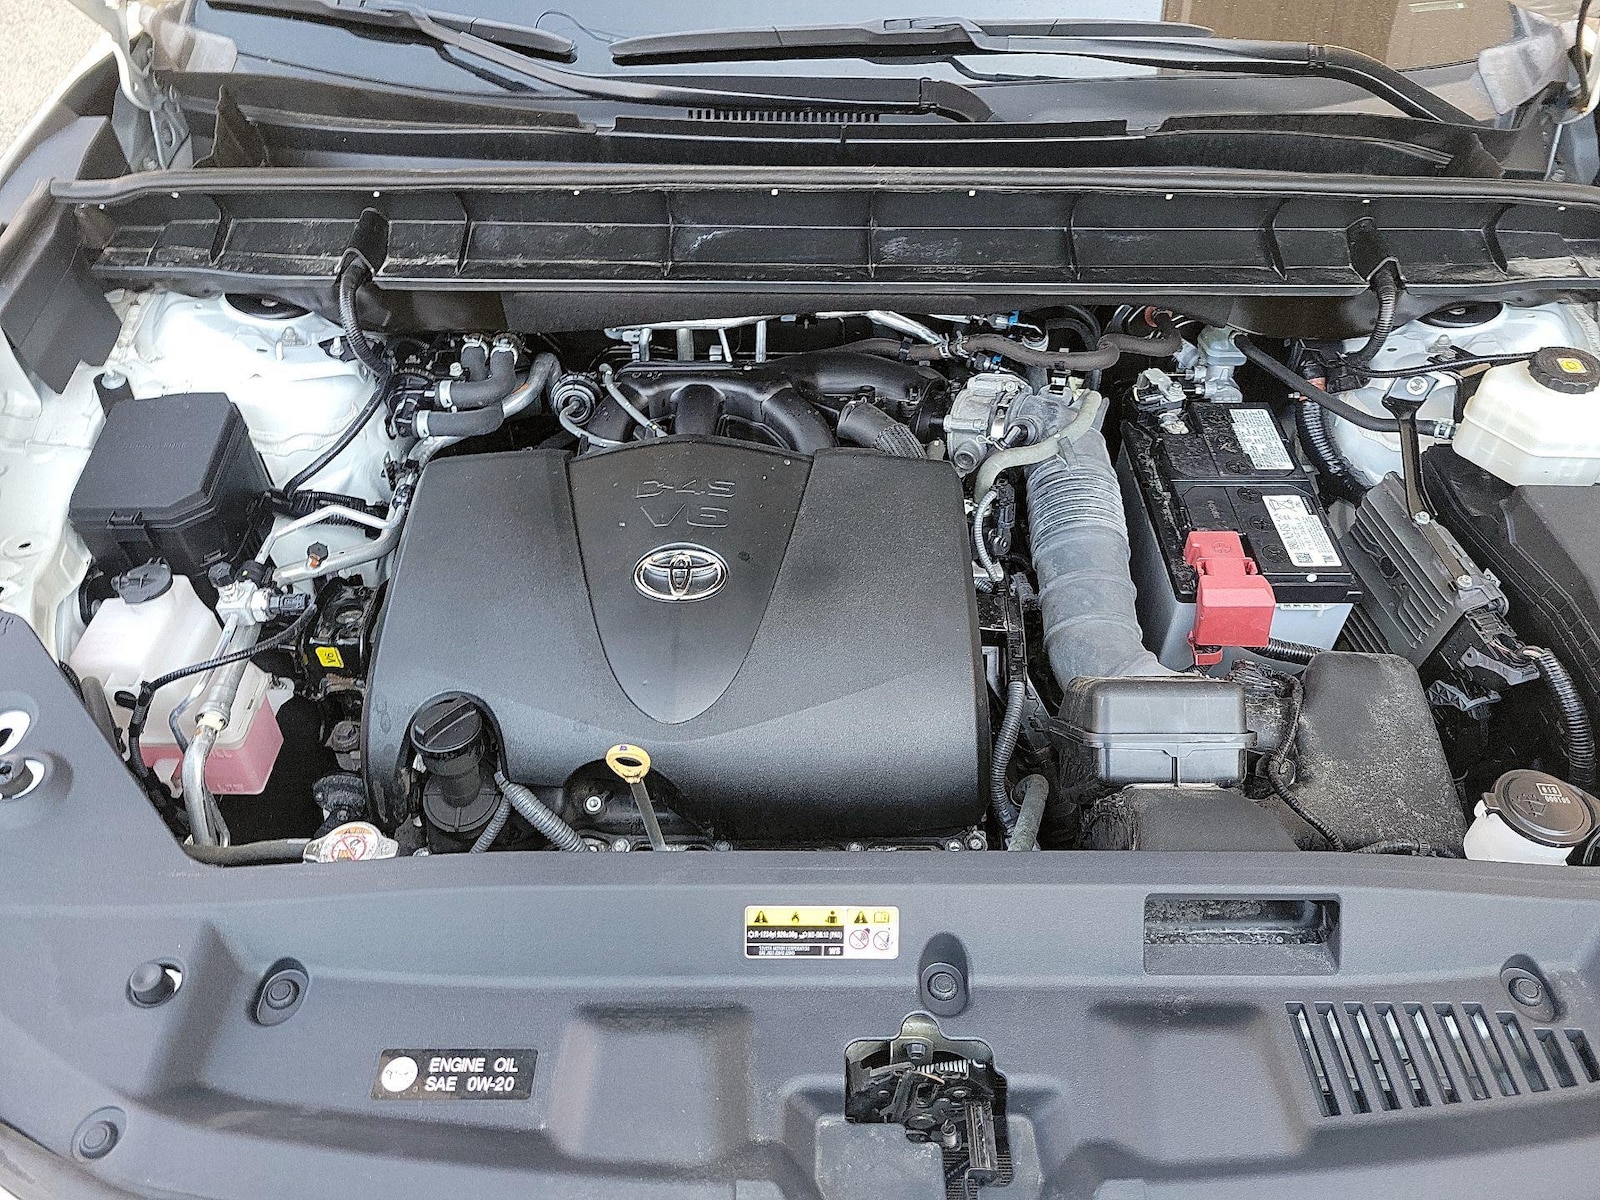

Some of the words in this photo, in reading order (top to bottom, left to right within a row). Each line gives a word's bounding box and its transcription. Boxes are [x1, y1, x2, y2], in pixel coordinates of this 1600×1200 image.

[640, 503, 729, 528] V6
[429, 1056, 486, 1073] ENGINE
[493, 1056, 518, 1073] OIL
[424, 1076, 458, 1092] SAE
[466, 1076, 515, 1092] 0W-20
